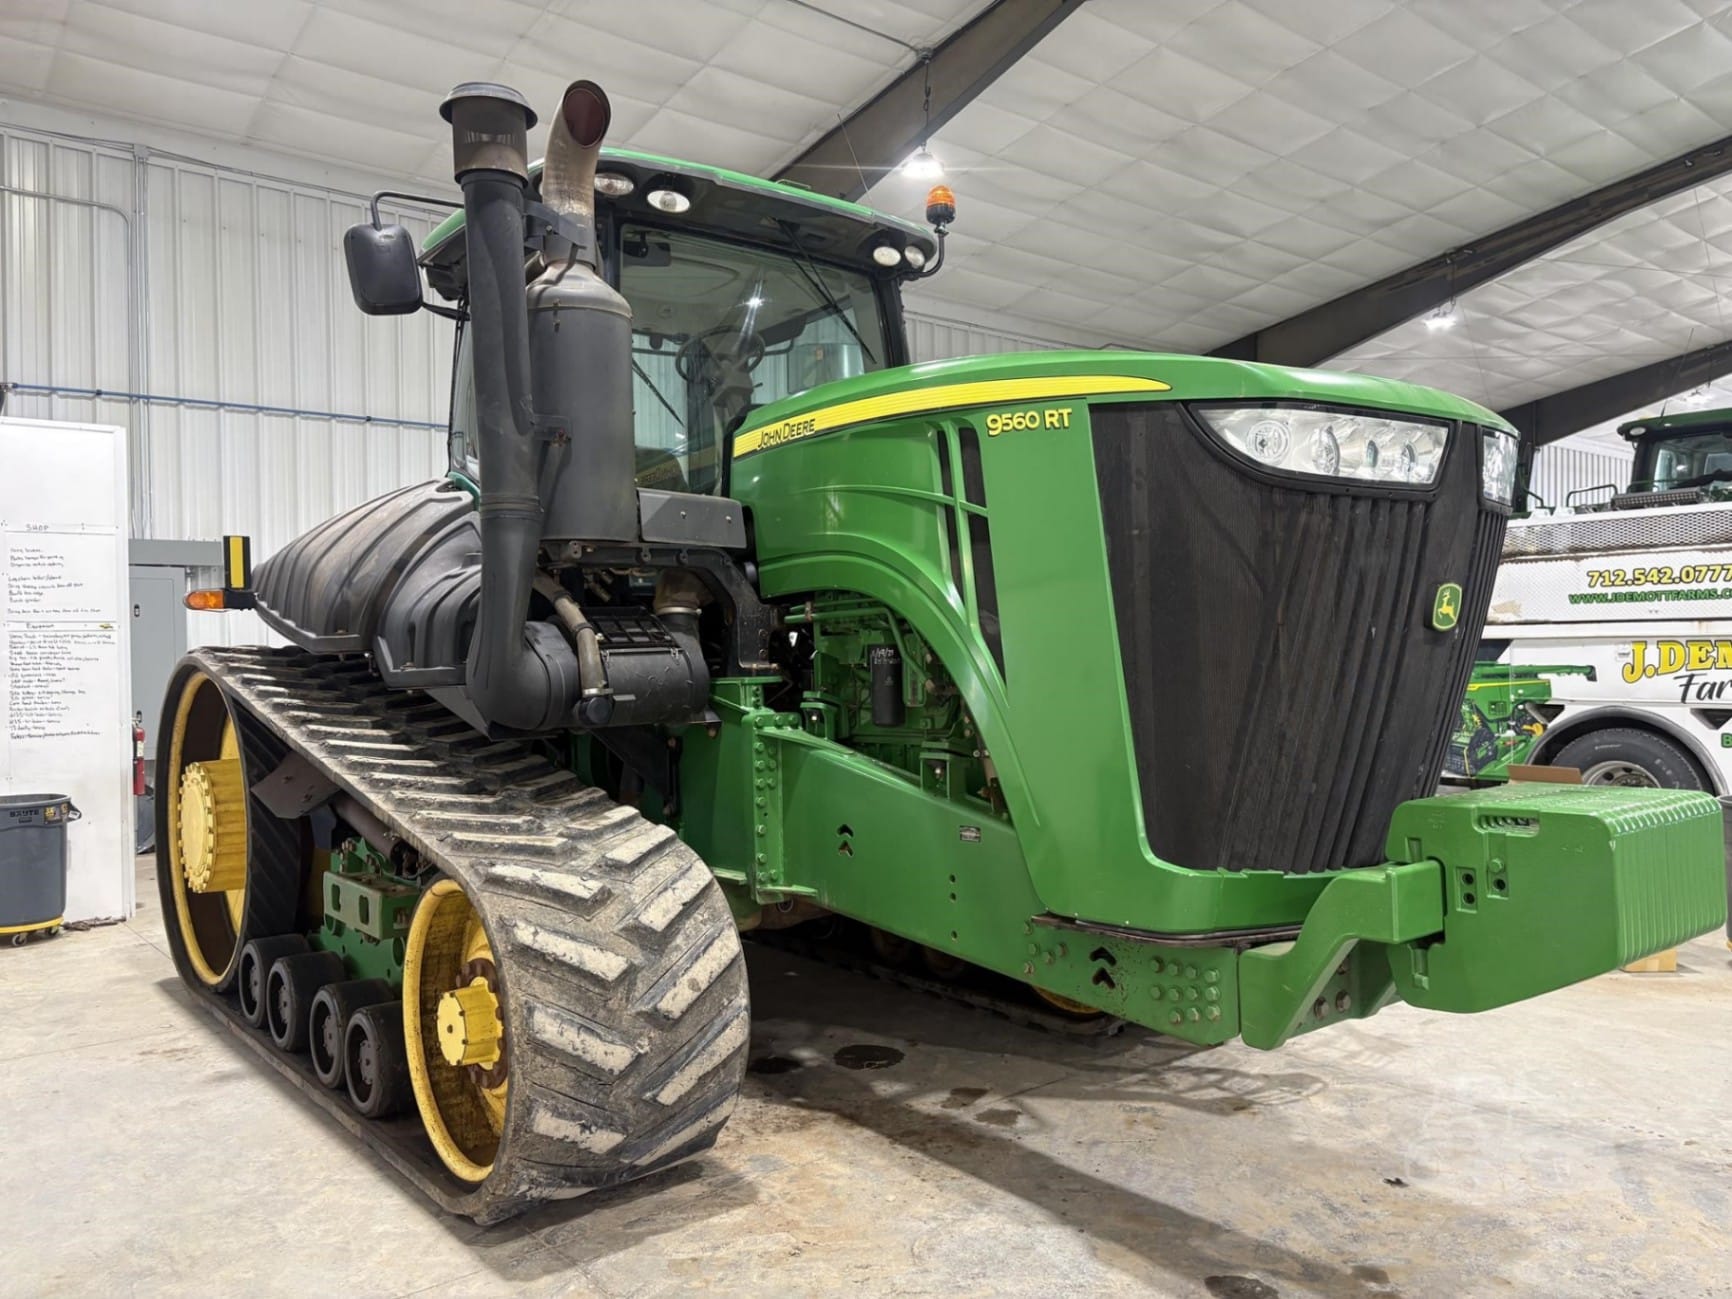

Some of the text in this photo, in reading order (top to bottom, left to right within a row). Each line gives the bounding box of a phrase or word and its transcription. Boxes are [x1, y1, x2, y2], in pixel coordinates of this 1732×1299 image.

[757, 418, 816, 449] JOHN DEERE
[985, 407, 1073, 437] 9560 RT
[1587, 563, 1732, 588] 712.542.0777
[1568, 588, 1732, 604] WWW.JDEMOTTFARMS.C
